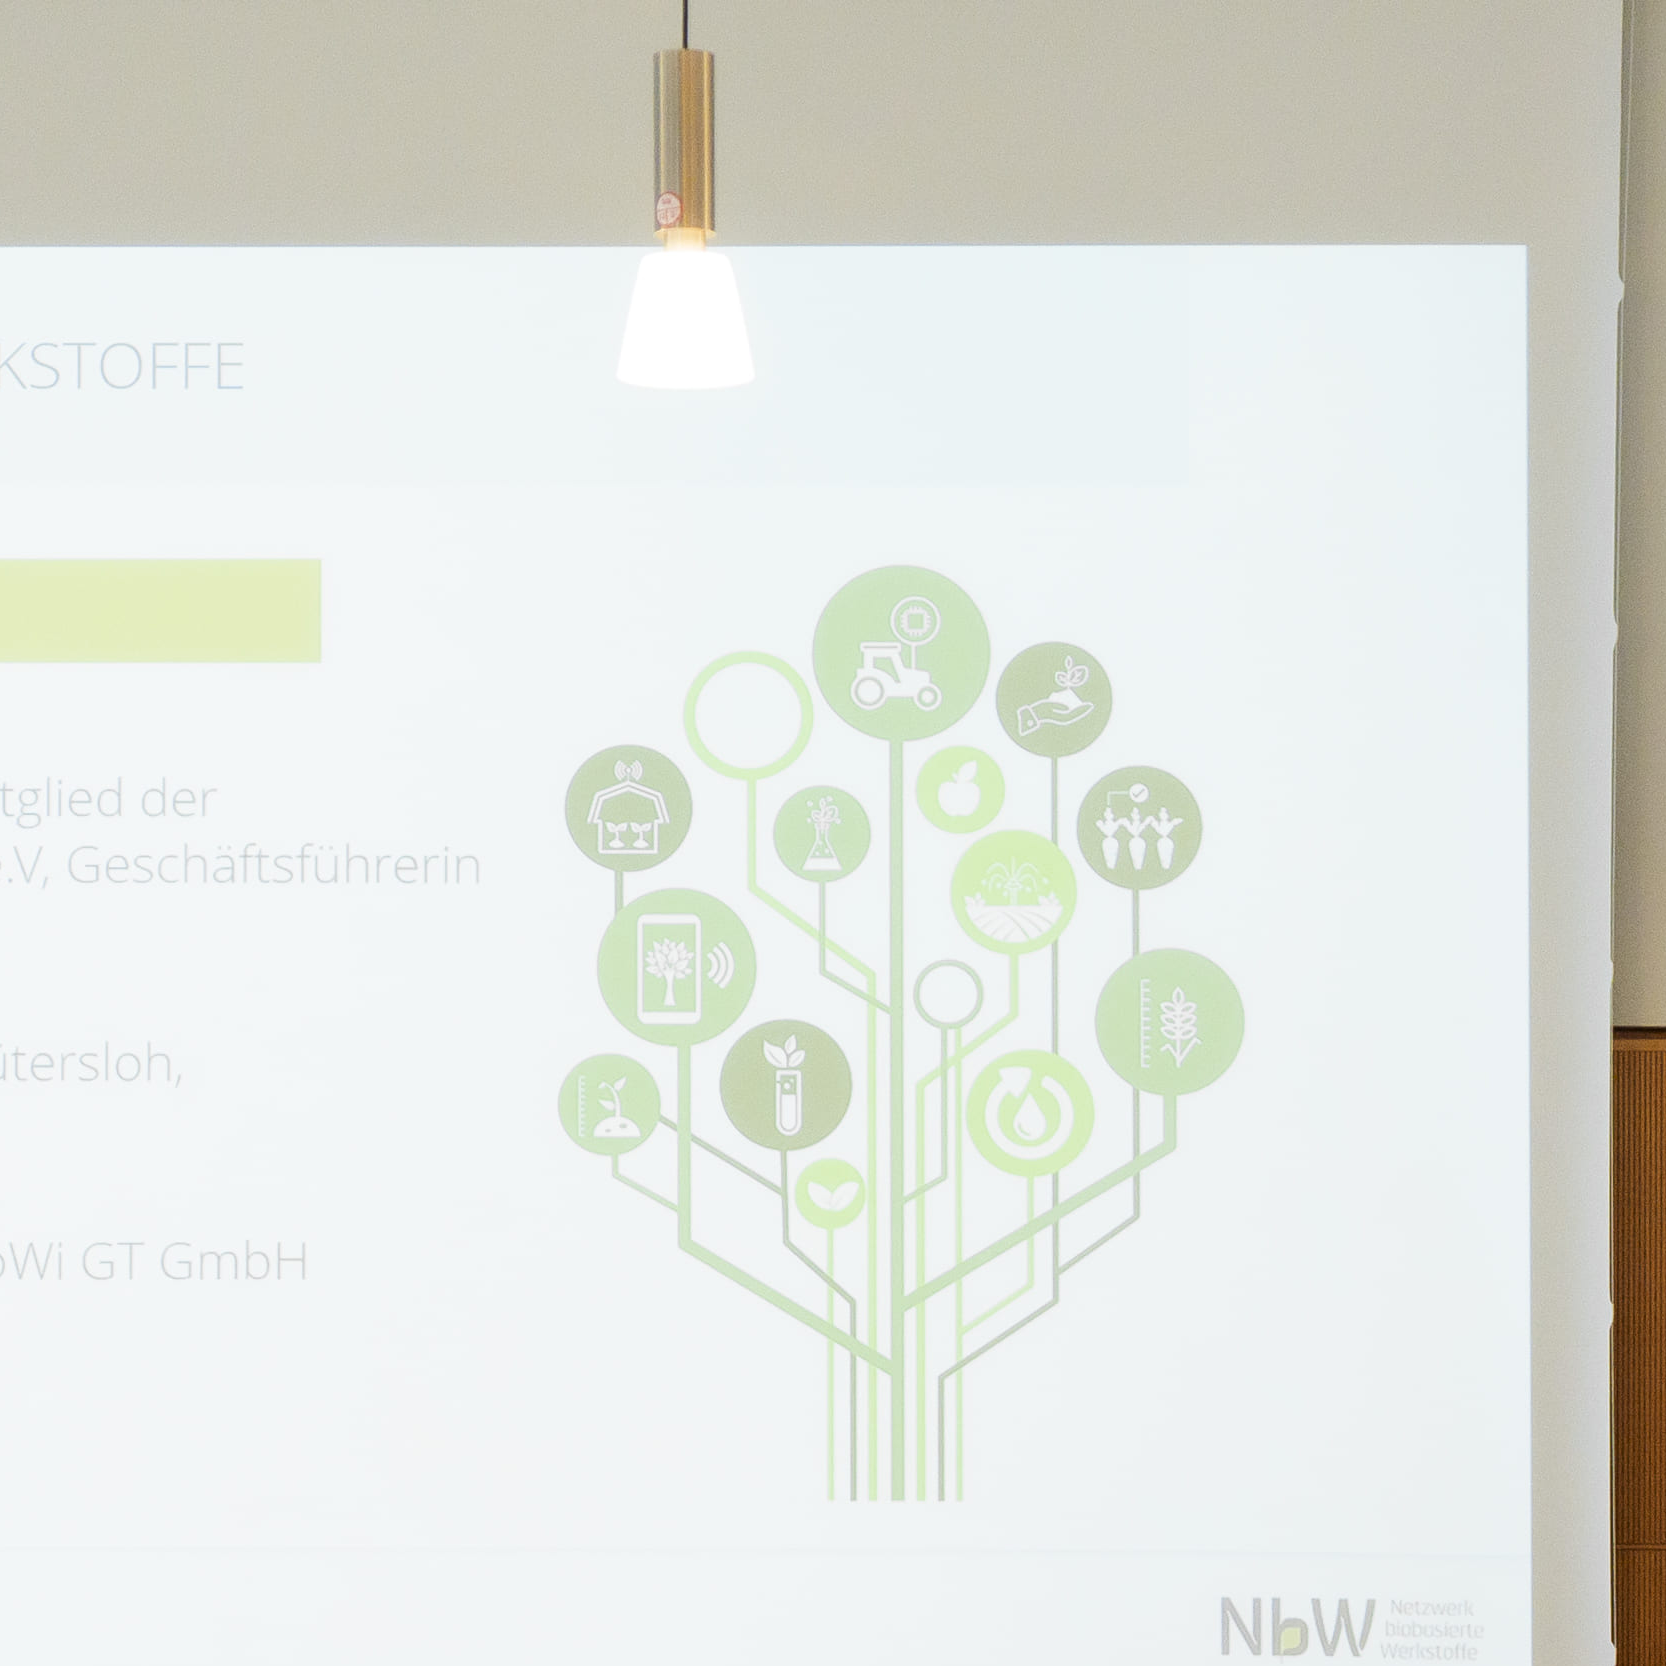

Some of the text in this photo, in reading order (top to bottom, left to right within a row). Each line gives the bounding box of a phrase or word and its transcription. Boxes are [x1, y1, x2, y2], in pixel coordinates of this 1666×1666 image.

[140, 775, 218, 819] der
[67, 842, 480, 885] Geschäftsführerin
[81, 1241, 146, 1281] GT
[159, 1239, 306, 1281] GmbH
[1220, 1595, 1377, 1658] NbW
[1390, 1599, 1474, 1617] Netzwerk
[1380, 1642, 1478, 1661] Werkstoffe
